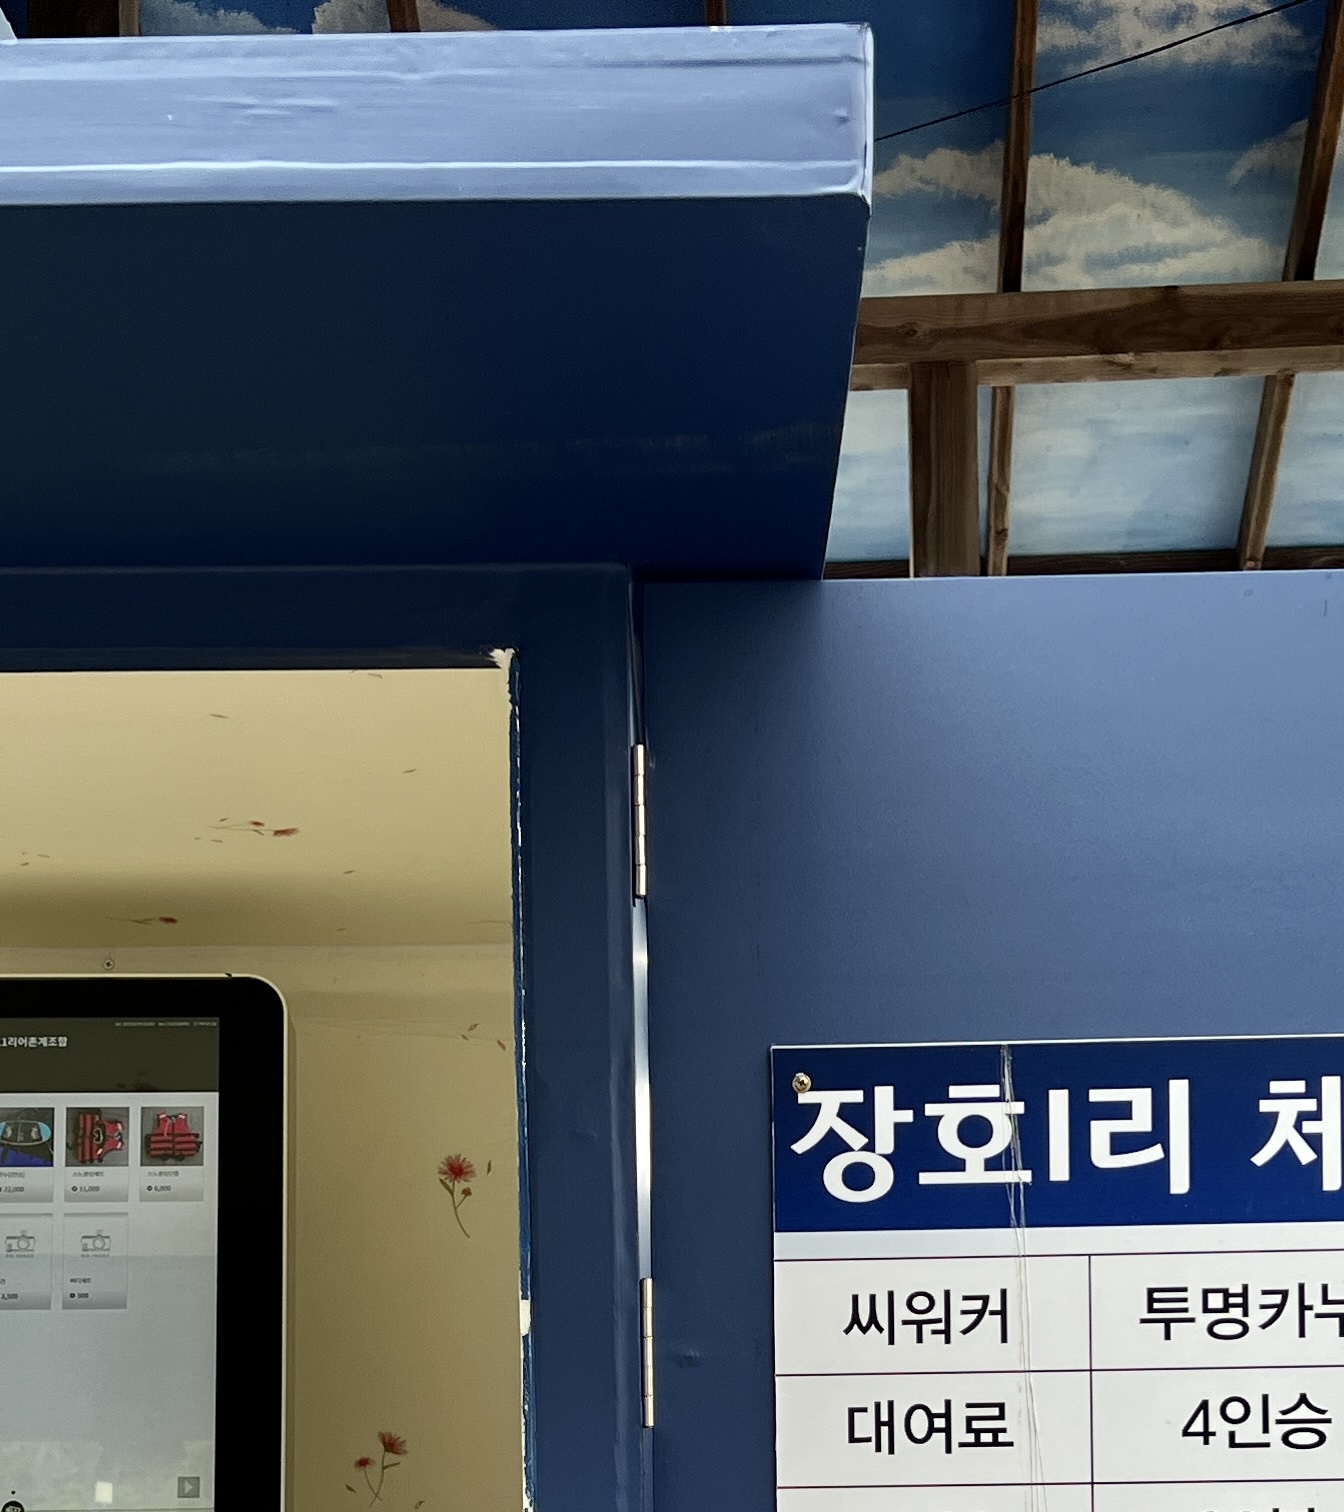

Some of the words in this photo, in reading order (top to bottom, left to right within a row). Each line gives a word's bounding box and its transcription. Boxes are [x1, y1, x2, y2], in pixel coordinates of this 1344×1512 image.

[844, 1289, 1010, 1345] 씨워커
[847, 1401, 1014, 1455] 대여료
[1181, 1392, 1332, 1449] 4인승
